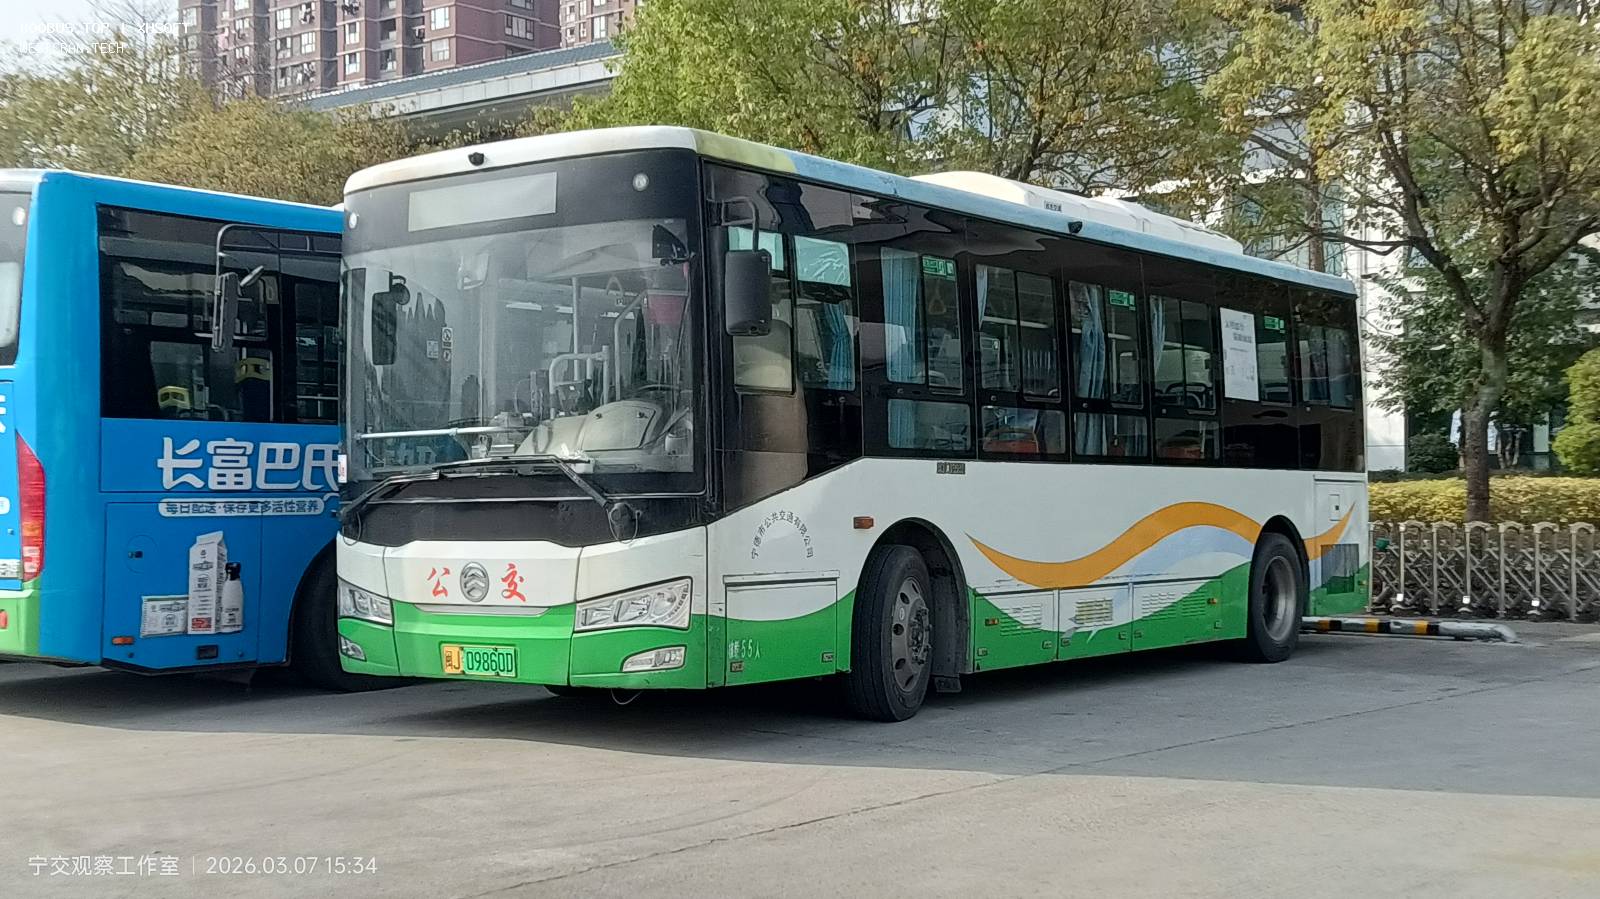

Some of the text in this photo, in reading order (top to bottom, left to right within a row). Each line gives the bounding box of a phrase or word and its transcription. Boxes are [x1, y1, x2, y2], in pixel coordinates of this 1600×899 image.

[156, 436, 340, 492] 长富巴氏
[751, 509, 814, 560] 宁德市公共交通有限公司
